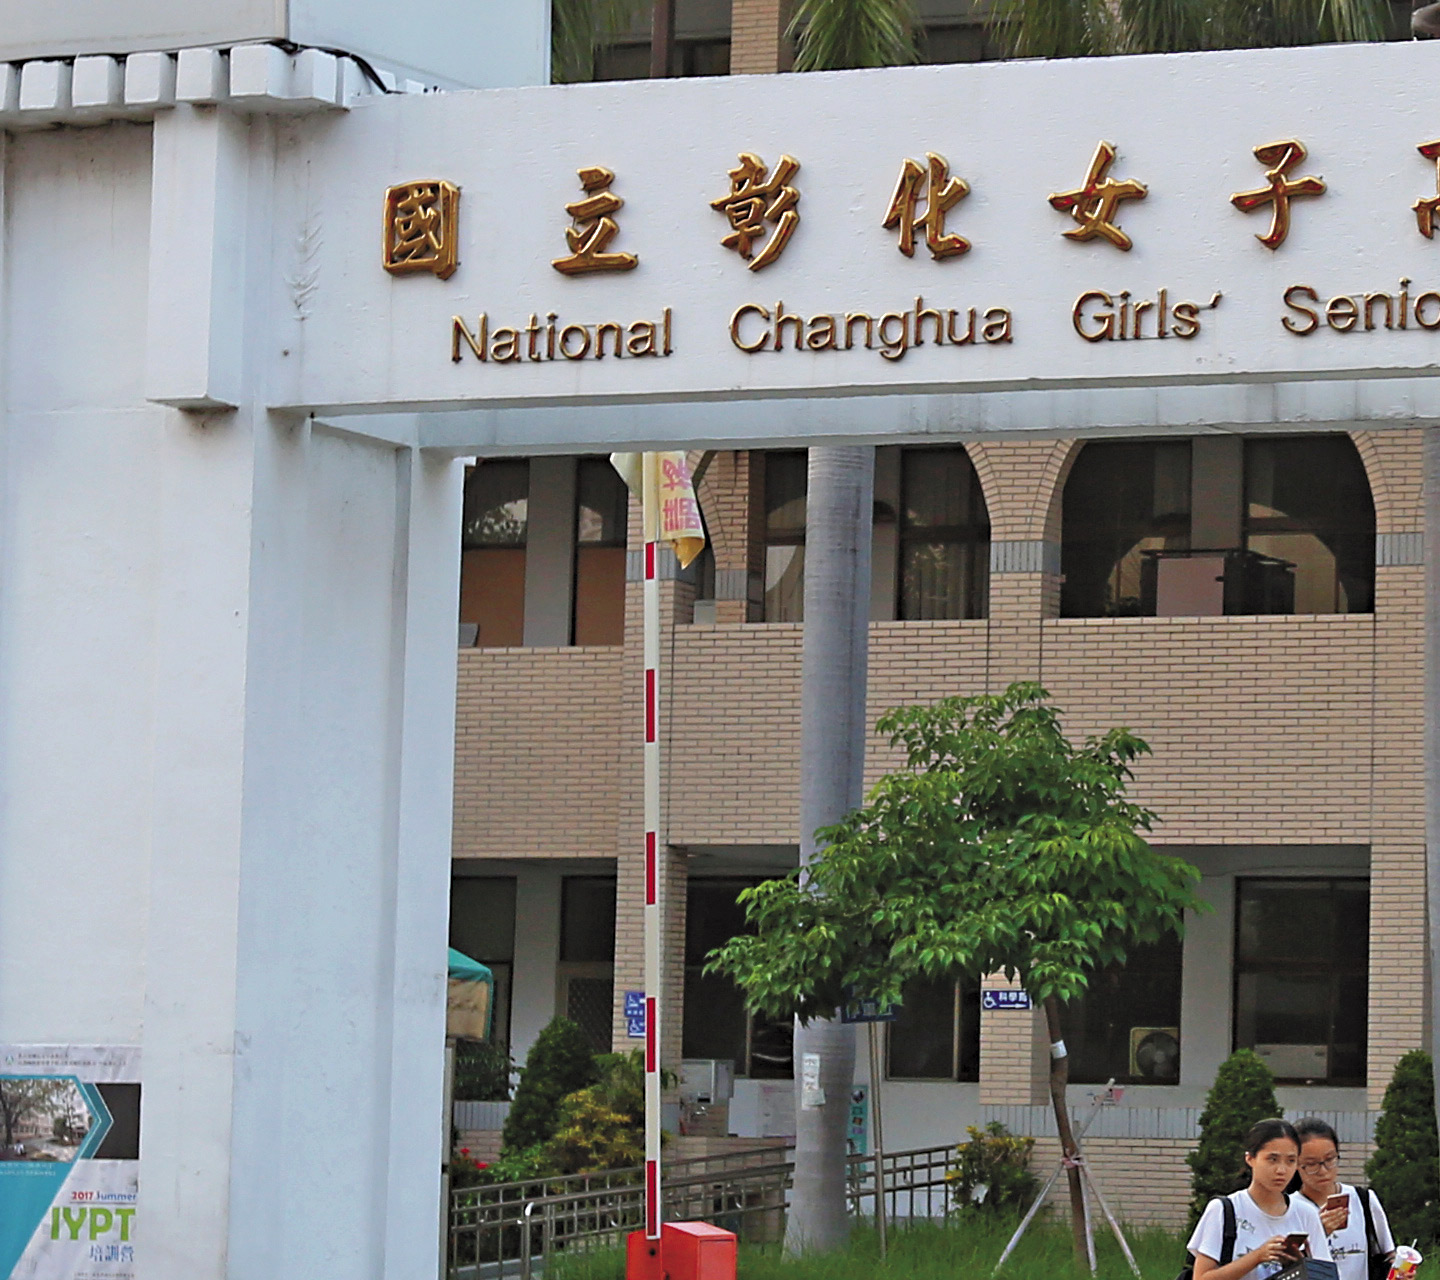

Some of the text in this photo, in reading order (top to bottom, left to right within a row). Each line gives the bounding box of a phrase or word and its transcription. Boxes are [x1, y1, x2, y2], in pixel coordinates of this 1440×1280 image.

[450, 306, 673, 364] National
[728, 295, 1014, 362] Changhua
[71, 1191, 137, 1201] 2017 Summer
[50, 1207, 136, 1241] IYPT
